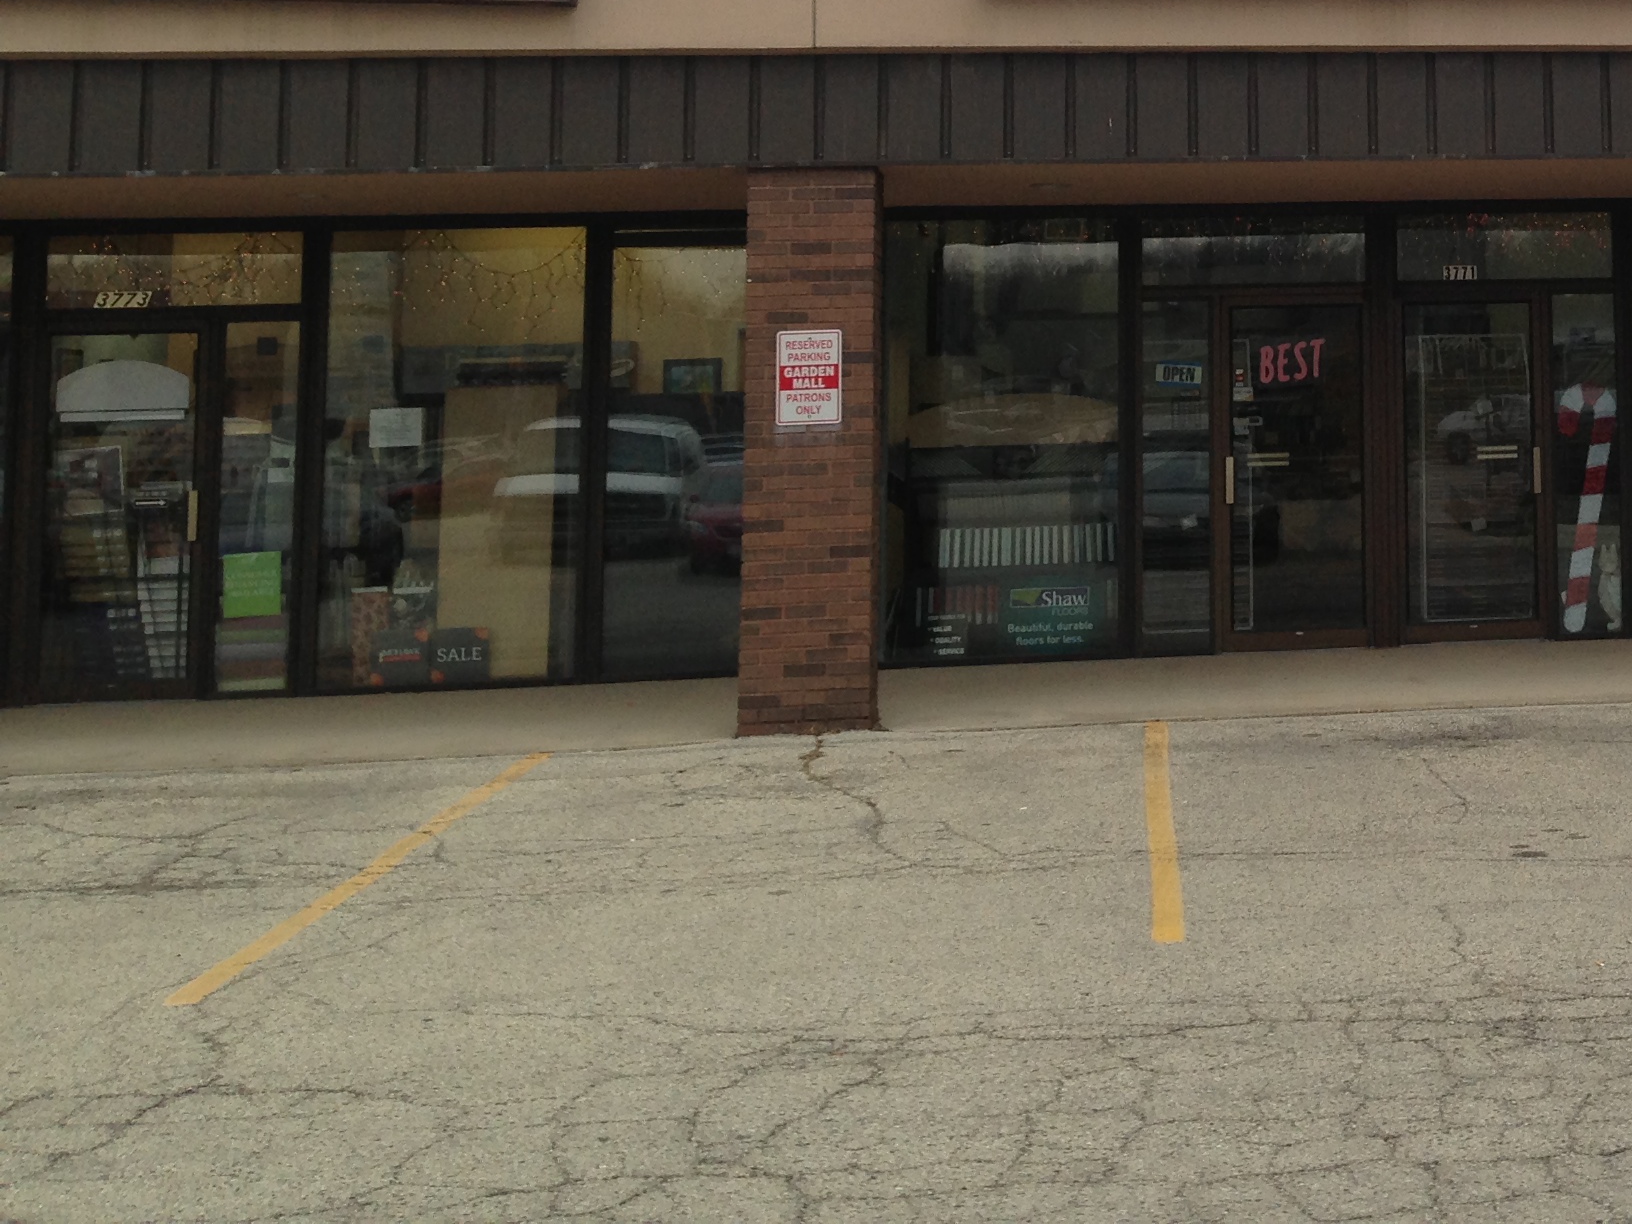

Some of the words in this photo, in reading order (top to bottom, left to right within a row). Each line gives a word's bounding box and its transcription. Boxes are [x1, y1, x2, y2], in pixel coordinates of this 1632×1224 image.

[1445, 266, 1475, 279] 3771
[97, 292, 149, 307] 3773
[786, 340, 833, 350] RESERVED
[788, 352, 831, 362] PARKING
[1260, 338, 1326, 384] BEST
[783, 366, 835, 378] GARDEN
[1162, 366, 1196, 382] OPEN
[792, 377, 825, 389] MALL
[786, 392, 832, 403] PATRONS
[795, 405, 822, 415] ONLY
[1041, 590, 1087, 607] Shaw
[1057, 620, 1094, 631] durable
[1047, 635, 1061, 644] for
[437, 647, 482, 662] SALE
